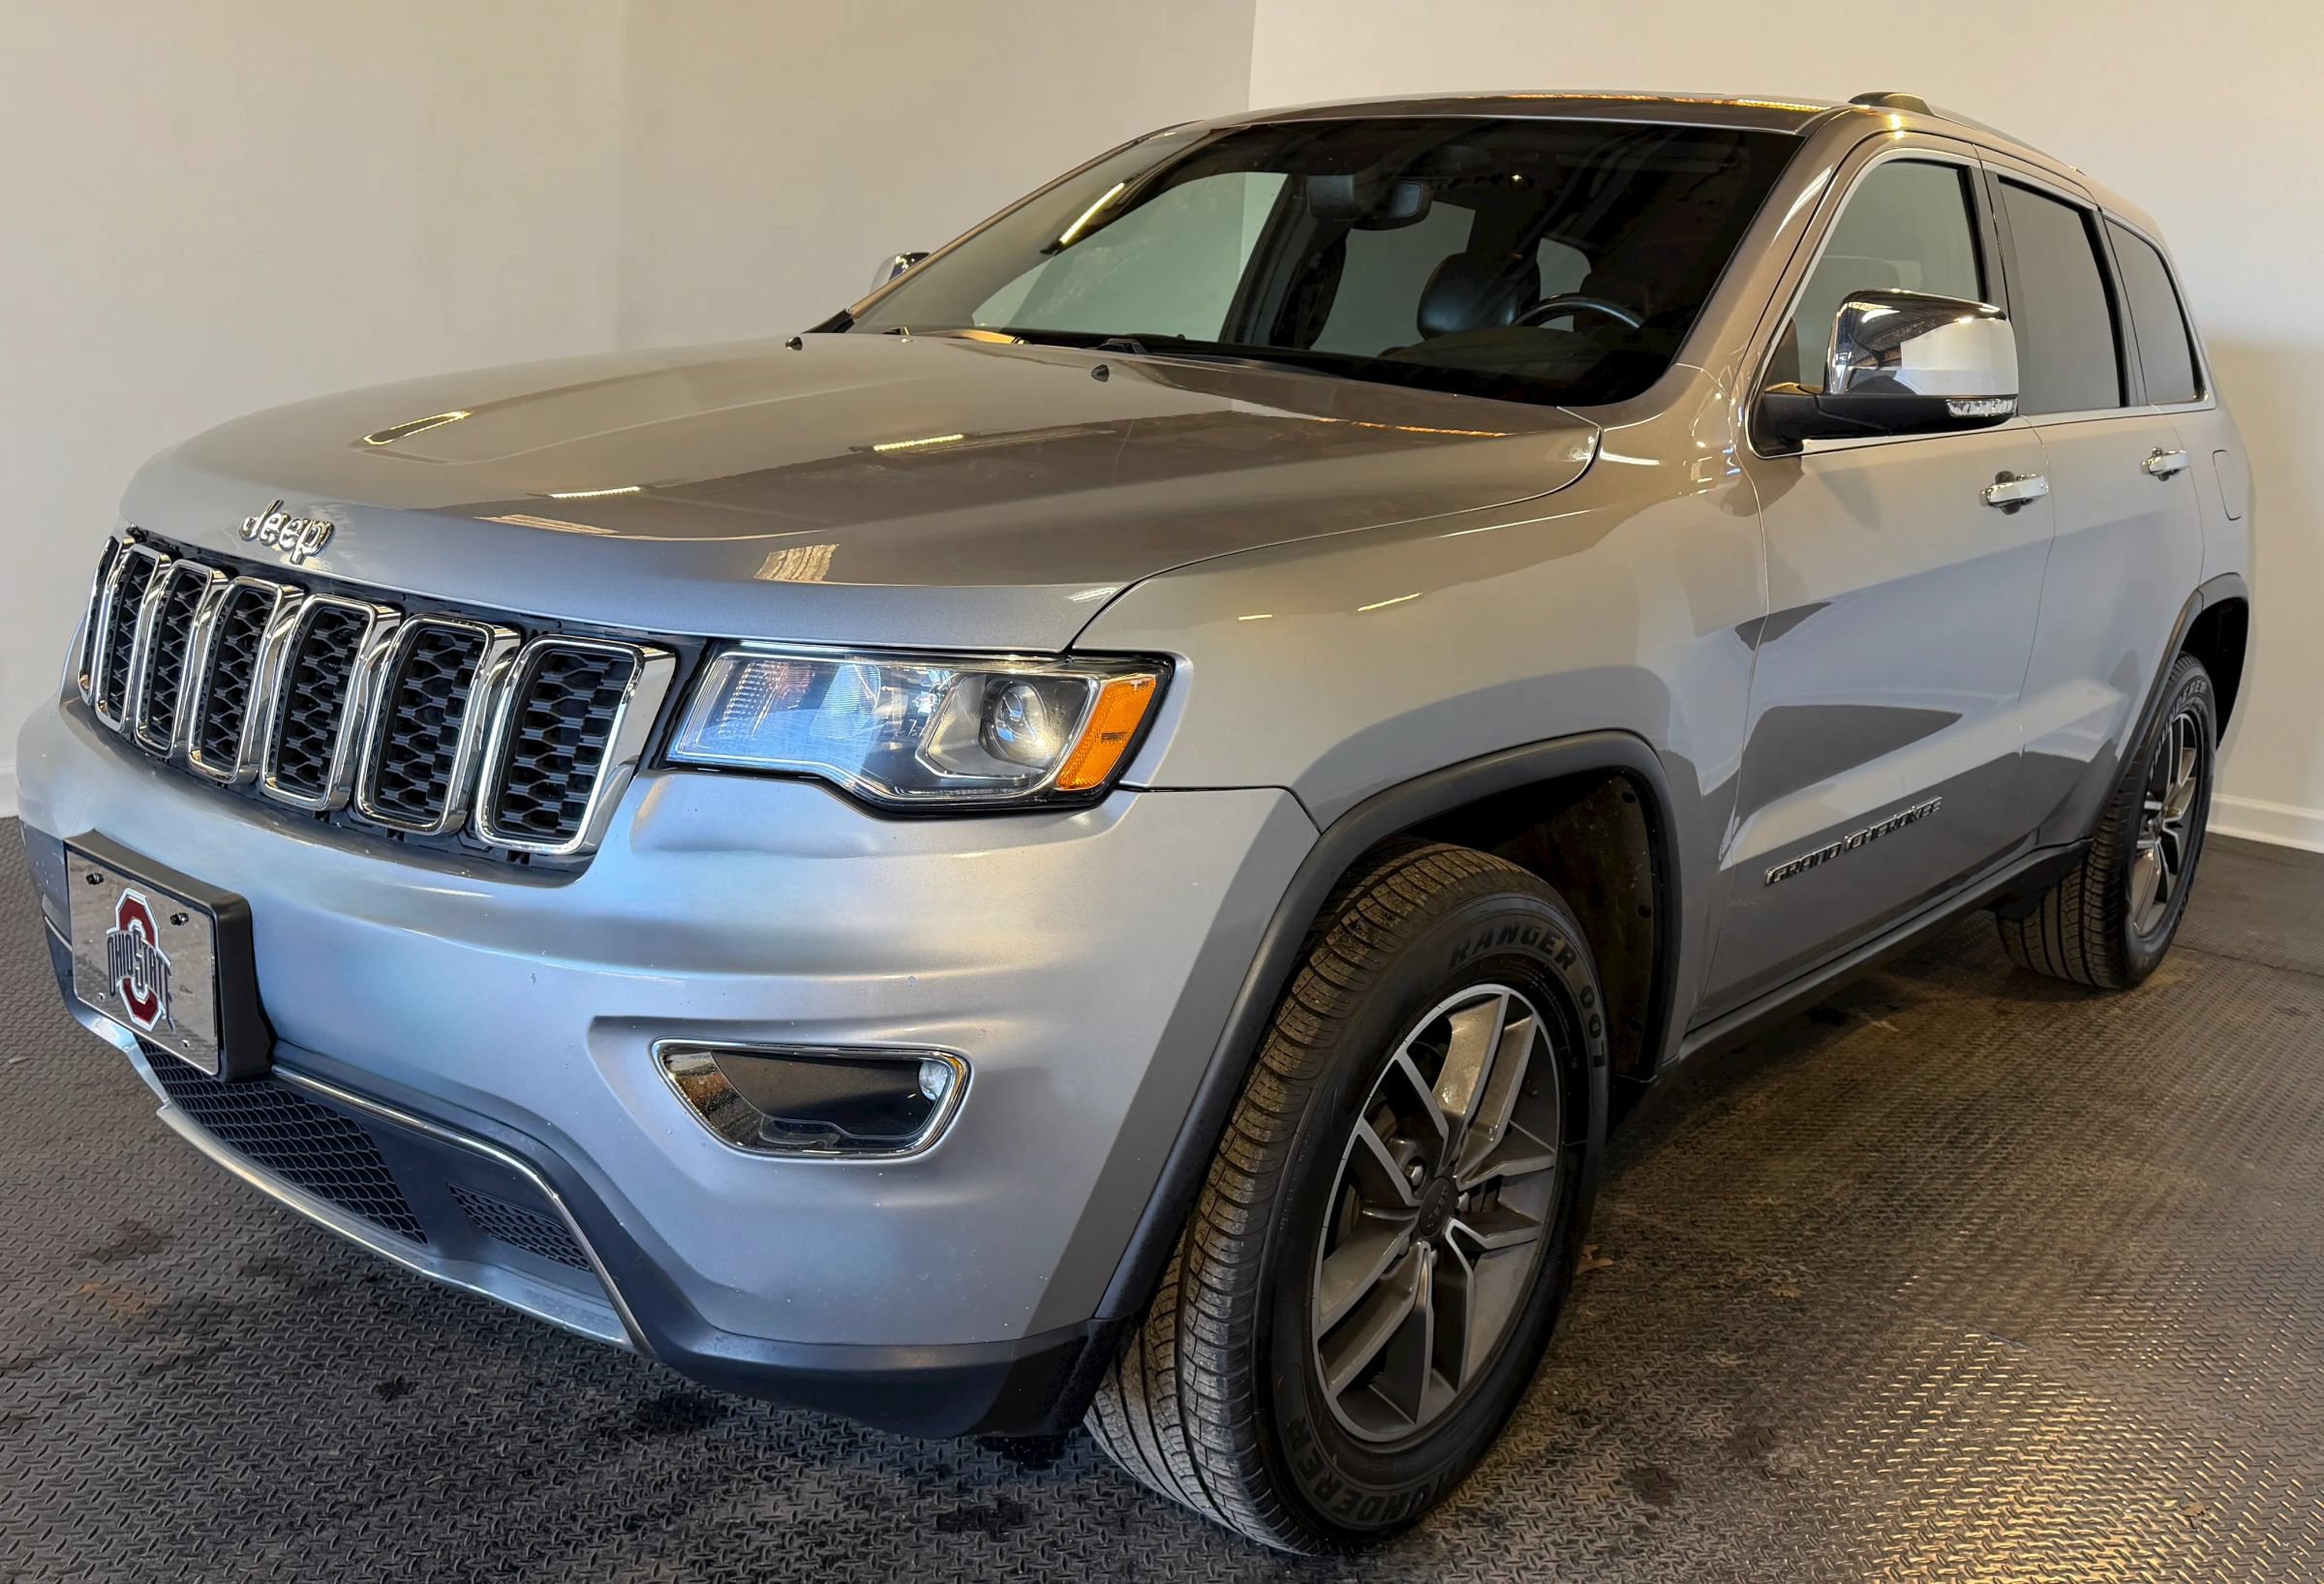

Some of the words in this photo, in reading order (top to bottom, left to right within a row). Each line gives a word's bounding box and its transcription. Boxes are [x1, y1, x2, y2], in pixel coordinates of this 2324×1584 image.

[239, 499, 335, 565] Jeep
[1764, 840, 1843, 886] GRAND
[1844, 796, 1943, 852] CHEROKEE
[1450, 921, 1578, 971] RANGER
